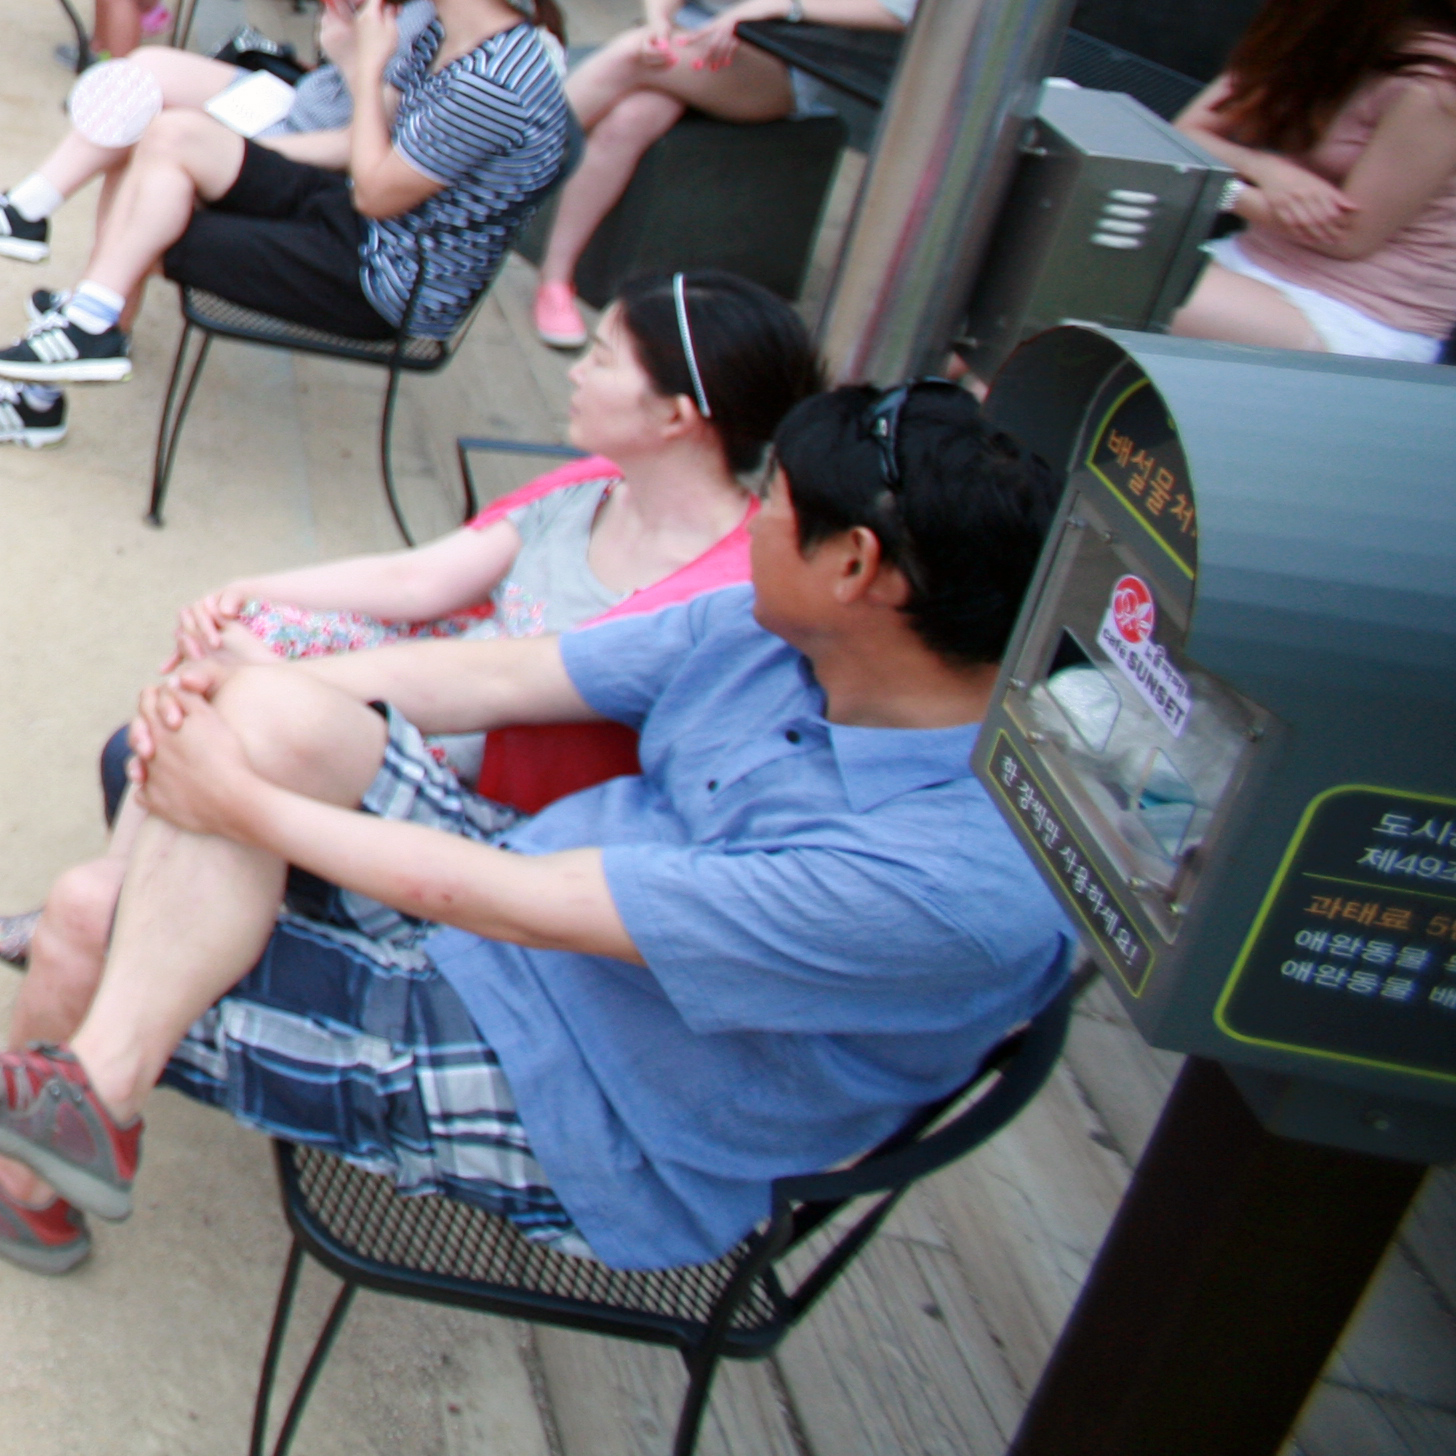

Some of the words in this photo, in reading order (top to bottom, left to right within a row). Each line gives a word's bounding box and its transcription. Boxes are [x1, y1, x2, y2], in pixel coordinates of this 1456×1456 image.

[1107, 428, 1197, 538] 배설물처
[1127, 650, 1186, 726] SUNSET
[1372, 812, 1456, 847] 도시
[1002, 755, 1018, 787] 한
[1059, 845, 1138, 966] 사용하세요!
[1303, 895, 1413, 931] 과태료
[1294, 928, 1429, 970] 애완동물
[1280, 959, 1415, 1001] 애완동물
